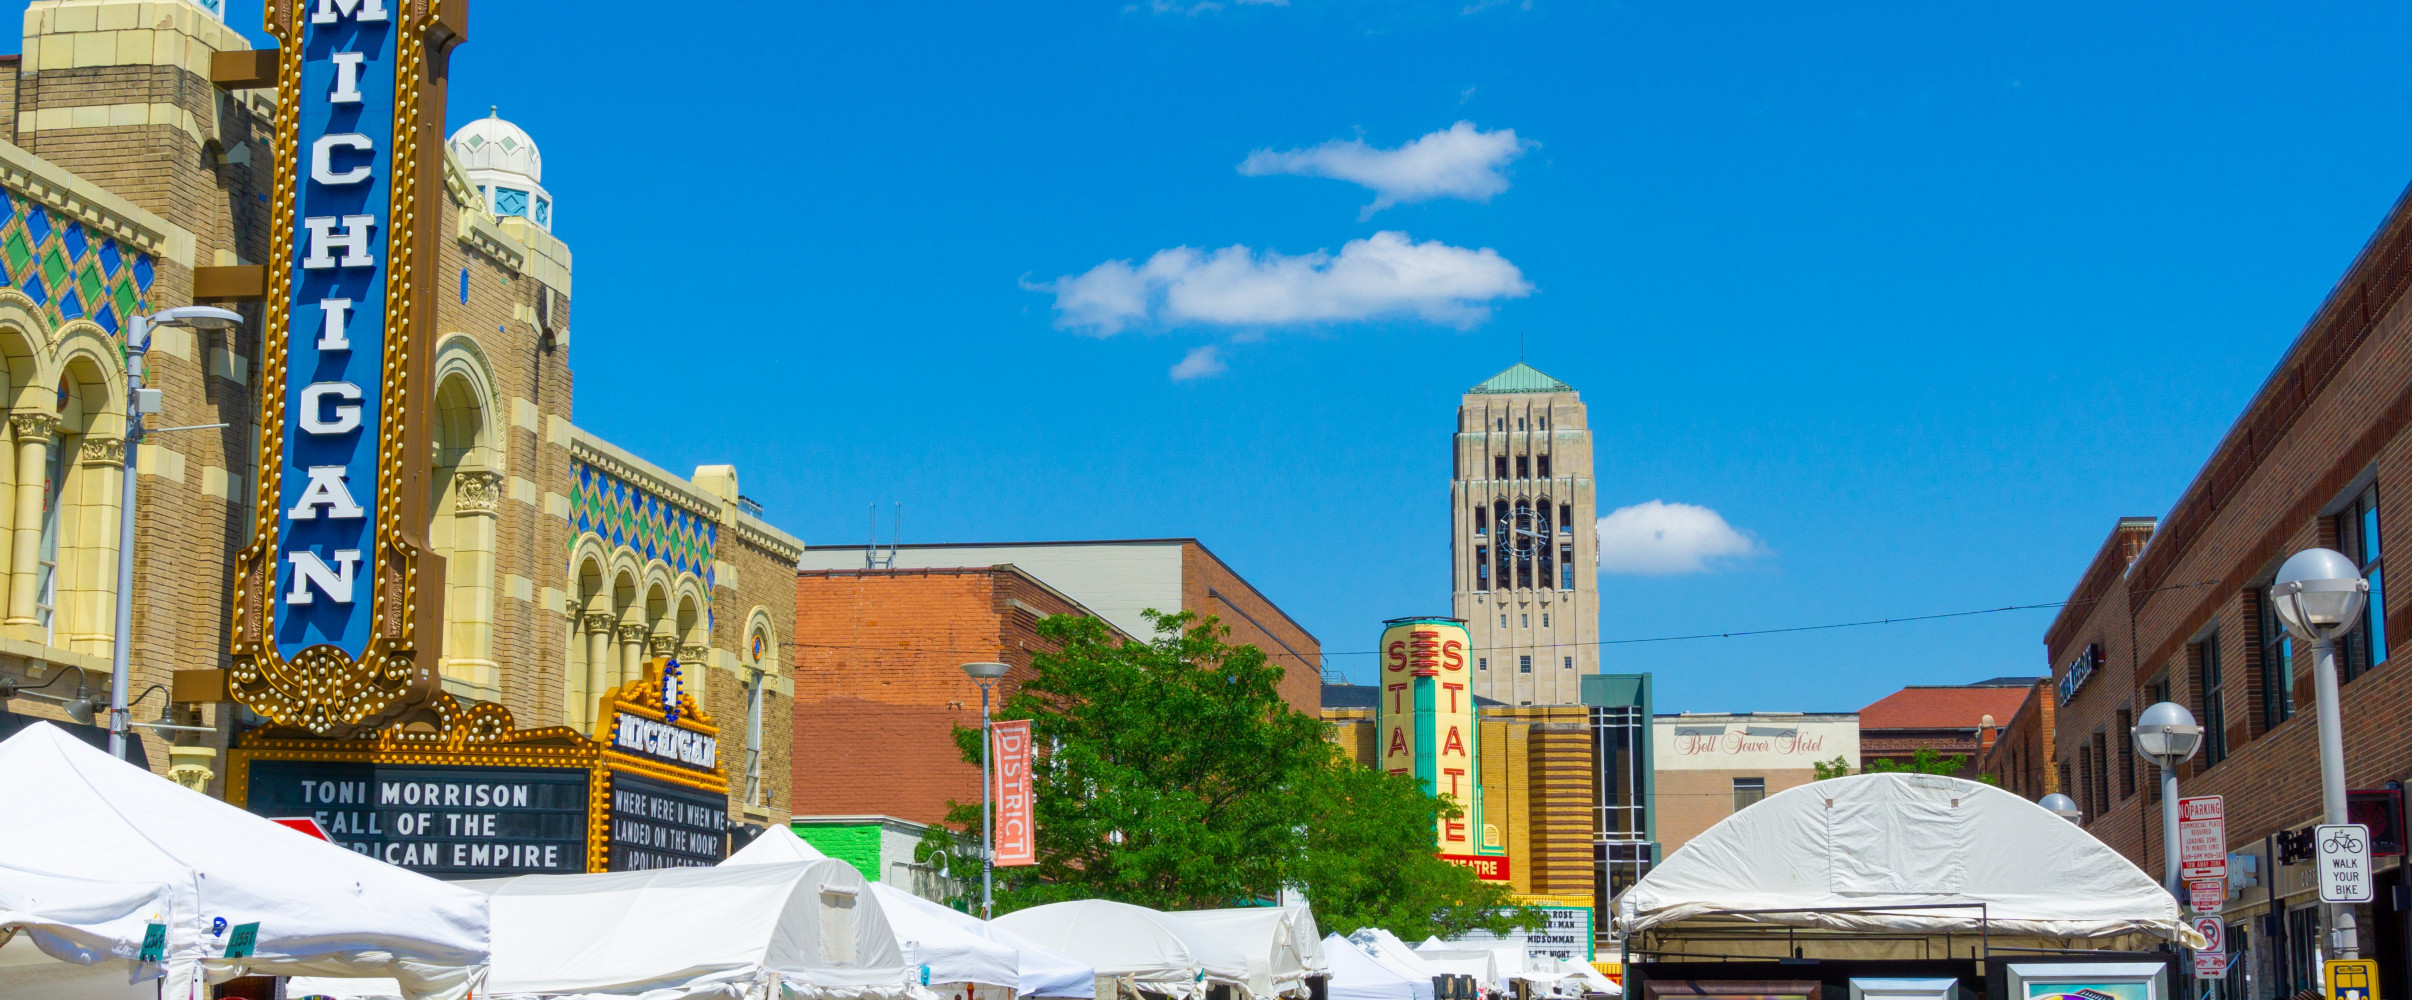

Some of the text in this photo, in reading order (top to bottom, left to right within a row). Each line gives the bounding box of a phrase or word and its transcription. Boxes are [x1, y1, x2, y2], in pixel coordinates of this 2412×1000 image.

[1388, 640, 1409, 777] STA
[618, 713, 717, 769] MICHIGAN
[1442, 640, 1466, 842] STATE
[1673, 729, 1823, 755] Bell Tower Hotel
[301, 780, 528, 807] TONI MORRISON
[1003, 736, 1024, 852] DISTRICT
[615, 789, 725, 831] WHERE WERE U WHEN WE
[2179, 802, 2220, 819] NO PARKING
[397, 812, 431, 836] OF
[446, 813, 496, 837] THE
[615, 819, 718, 856] LANDED ON THE MOON?
[338, 842, 558, 868] RICAN EMPIRE
[2332, 858, 2358, 868] WALK
[2333, 871, 2359, 881] YOUR
[2335, 884, 2358, 895] BIKE
[1553, 911, 1573, 919] ROSE
[1527, 935, 1575, 943] MIDSOMMAR
[1549, 950, 1570, 959] NIGHT
